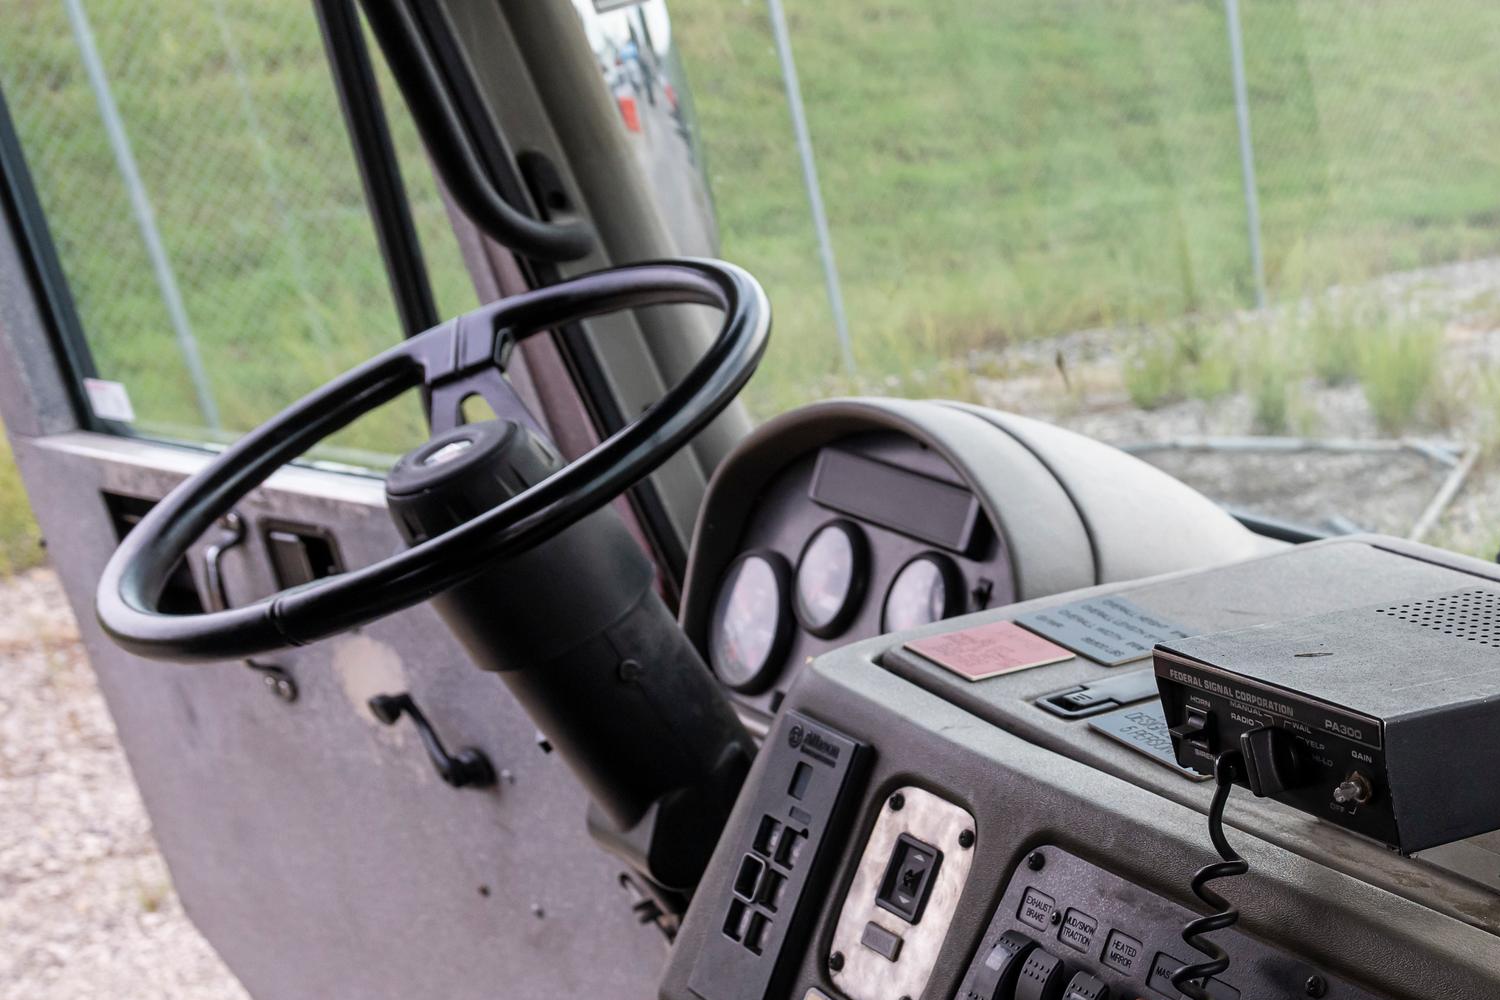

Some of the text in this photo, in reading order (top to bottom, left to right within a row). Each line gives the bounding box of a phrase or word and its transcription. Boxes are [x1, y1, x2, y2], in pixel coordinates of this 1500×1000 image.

[1169, 668, 1294, 717] FEDERAL SIGNAL CORPORATION
[1190, 695, 1211, 708] HORN
[1230, 700, 1263, 717] MANUAL
[1230, 712, 1255, 727] RADIO
[1292, 721, 1312, 735] WAIL
[1324, 719, 1363, 740] PA300
[1304, 738, 1325, 750] YELP
[1351, 750, 1373, 764] GAIN
[1025, 895, 1053, 915] EXHAUST
[1025, 907, 1046, 924] BRAKE
[1065, 915, 1097, 937] MUD/SNOW
[1062, 927, 1092, 947] TRACTION
[1112, 939, 1137, 958] HEATED
[1110, 949, 1132, 969] MIRROR
[1156, 966, 1173, 980] MAS
